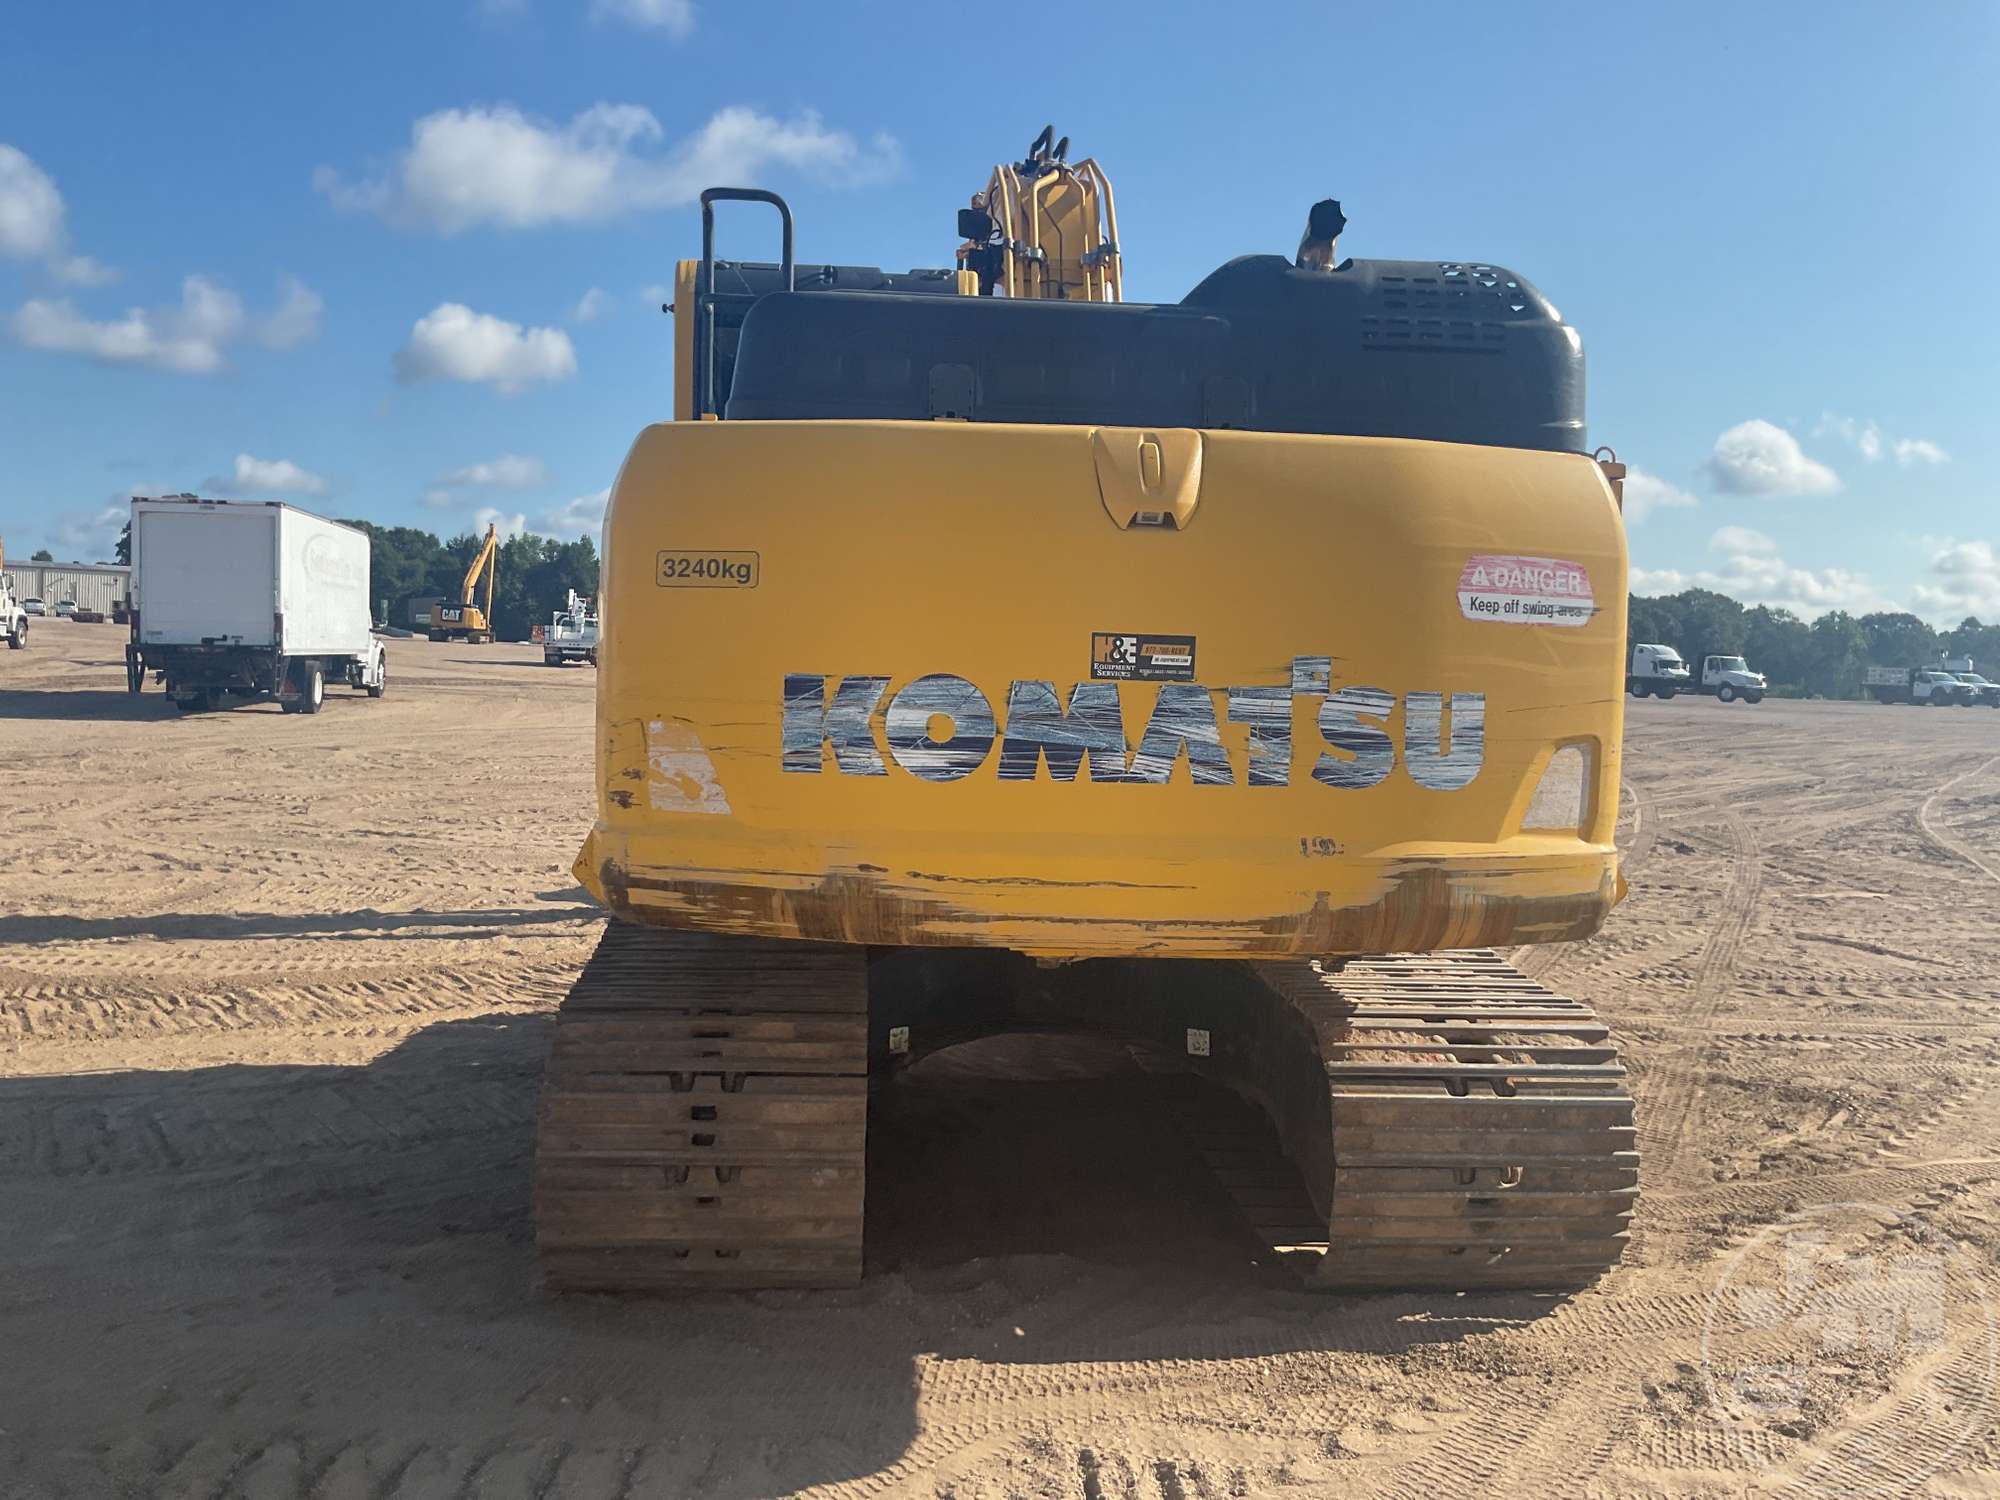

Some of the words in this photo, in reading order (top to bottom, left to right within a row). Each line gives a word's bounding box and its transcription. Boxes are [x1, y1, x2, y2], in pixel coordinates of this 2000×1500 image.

[663, 558, 751, 584] 3240kg
[1494, 566, 1581, 593] DANGER
[442, 608, 461, 621] CAT
[1470, 595, 1500, 614] Keep
[1504, 599, 1520, 613] off
[1522, 600, 1554, 618] swing
[1094, 636, 1137, 663] H&E
[782, 656, 1486, 791] KOMATSU
